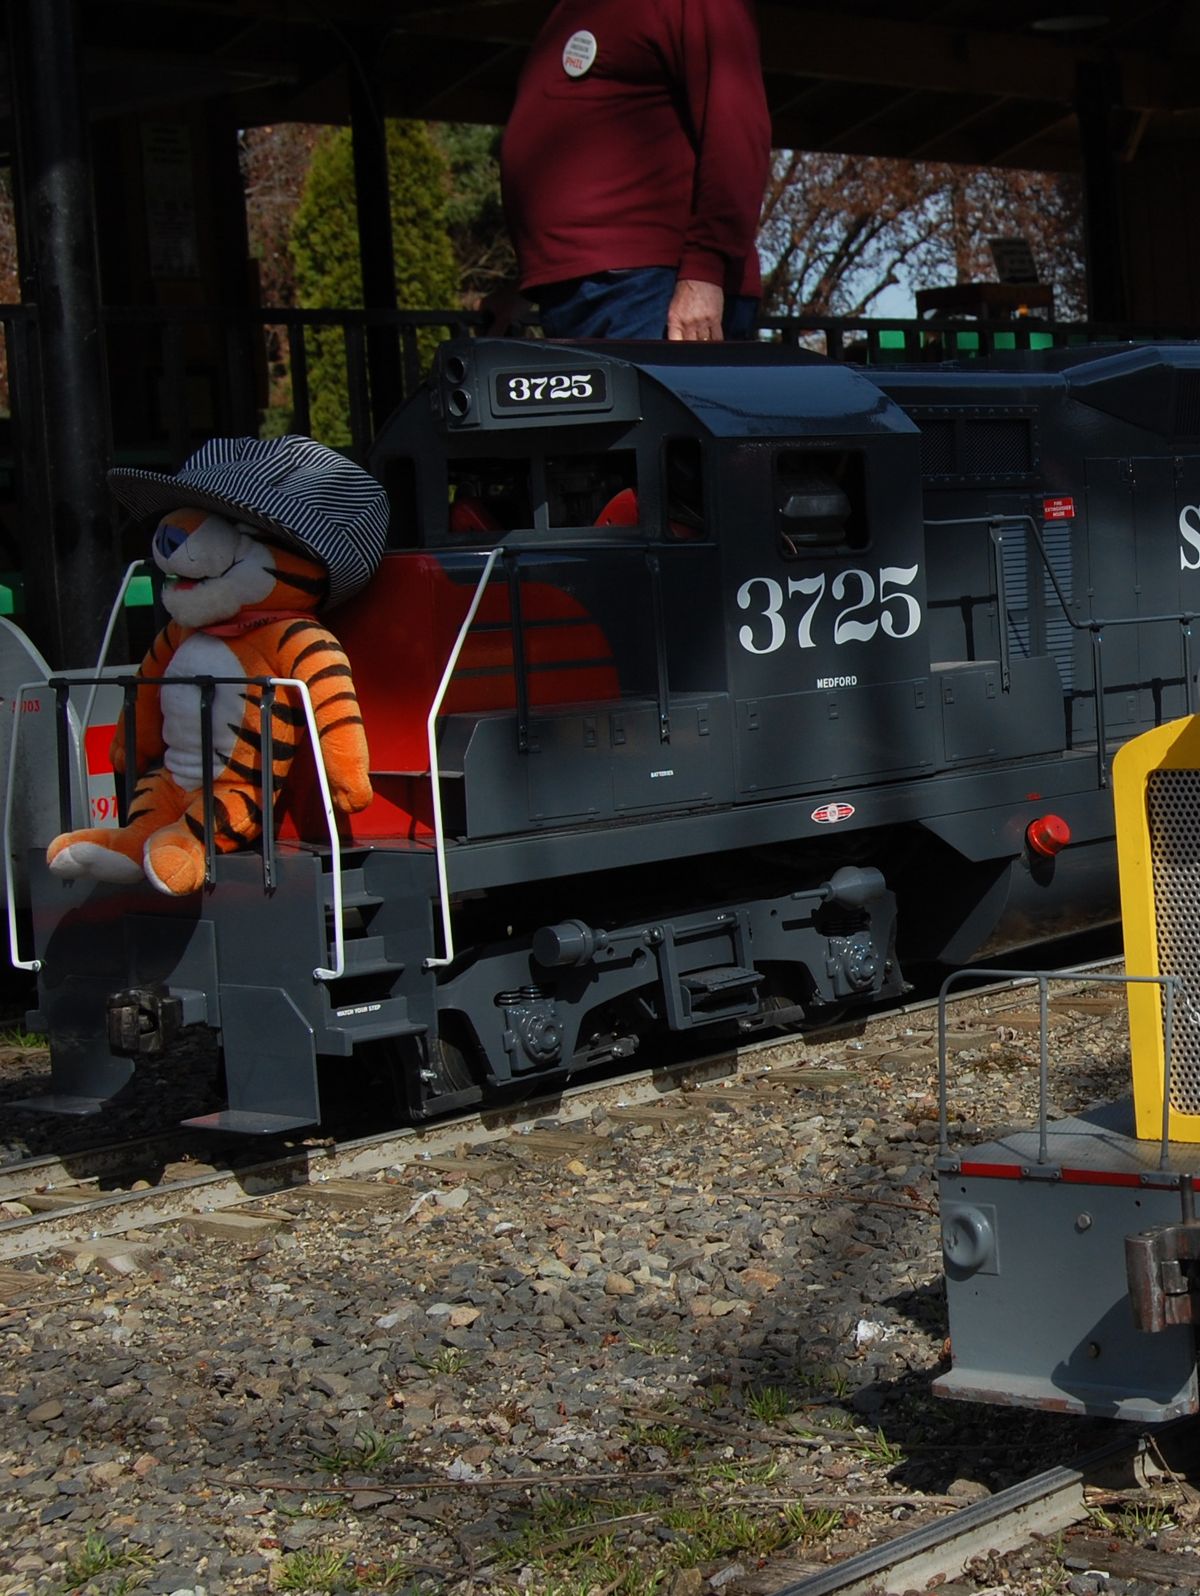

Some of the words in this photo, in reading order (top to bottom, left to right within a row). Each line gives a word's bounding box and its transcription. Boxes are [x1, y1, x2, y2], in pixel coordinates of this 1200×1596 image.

[508, 374, 593, 401] 3725
[737, 564, 922, 655] 3725
[816, 675, 858, 689] MEDFORD
